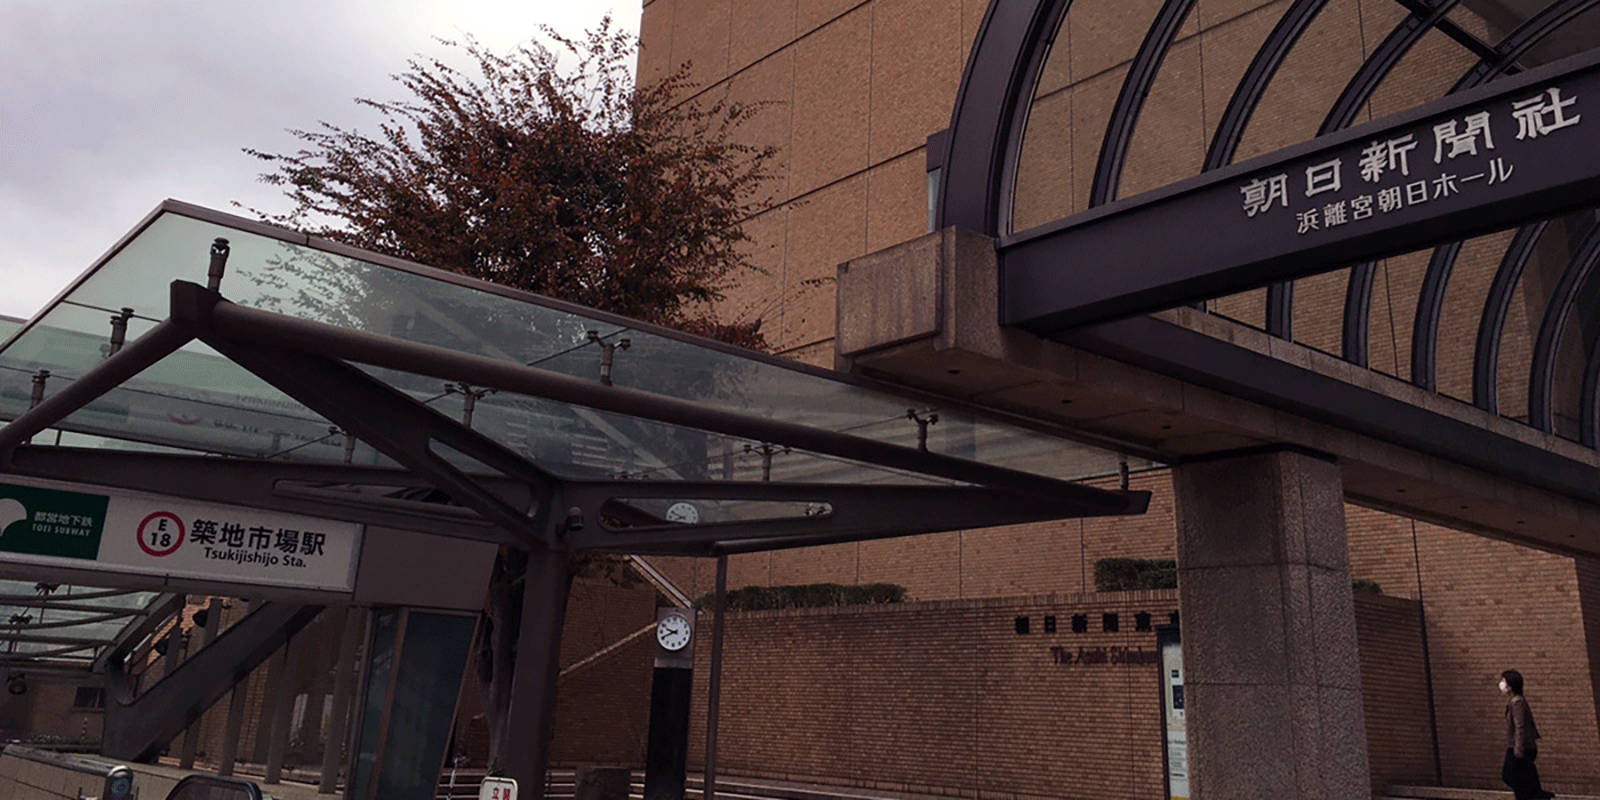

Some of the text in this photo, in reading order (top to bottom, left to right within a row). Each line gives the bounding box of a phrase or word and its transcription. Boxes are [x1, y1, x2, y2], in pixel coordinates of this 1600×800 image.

[1240, 87, 1581, 217] 朝日新聞社
[1297, 157, 1514, 234] 浜離宮朝日ホール
[32, 523, 91, 537] TOEI SUBWAY
[159, 519, 167, 531] E
[151, 533, 171, 547] 18
[190, 519, 326, 556] 築地市場駅
[204, 547, 306, 568] Tsukijishijo Sta.
